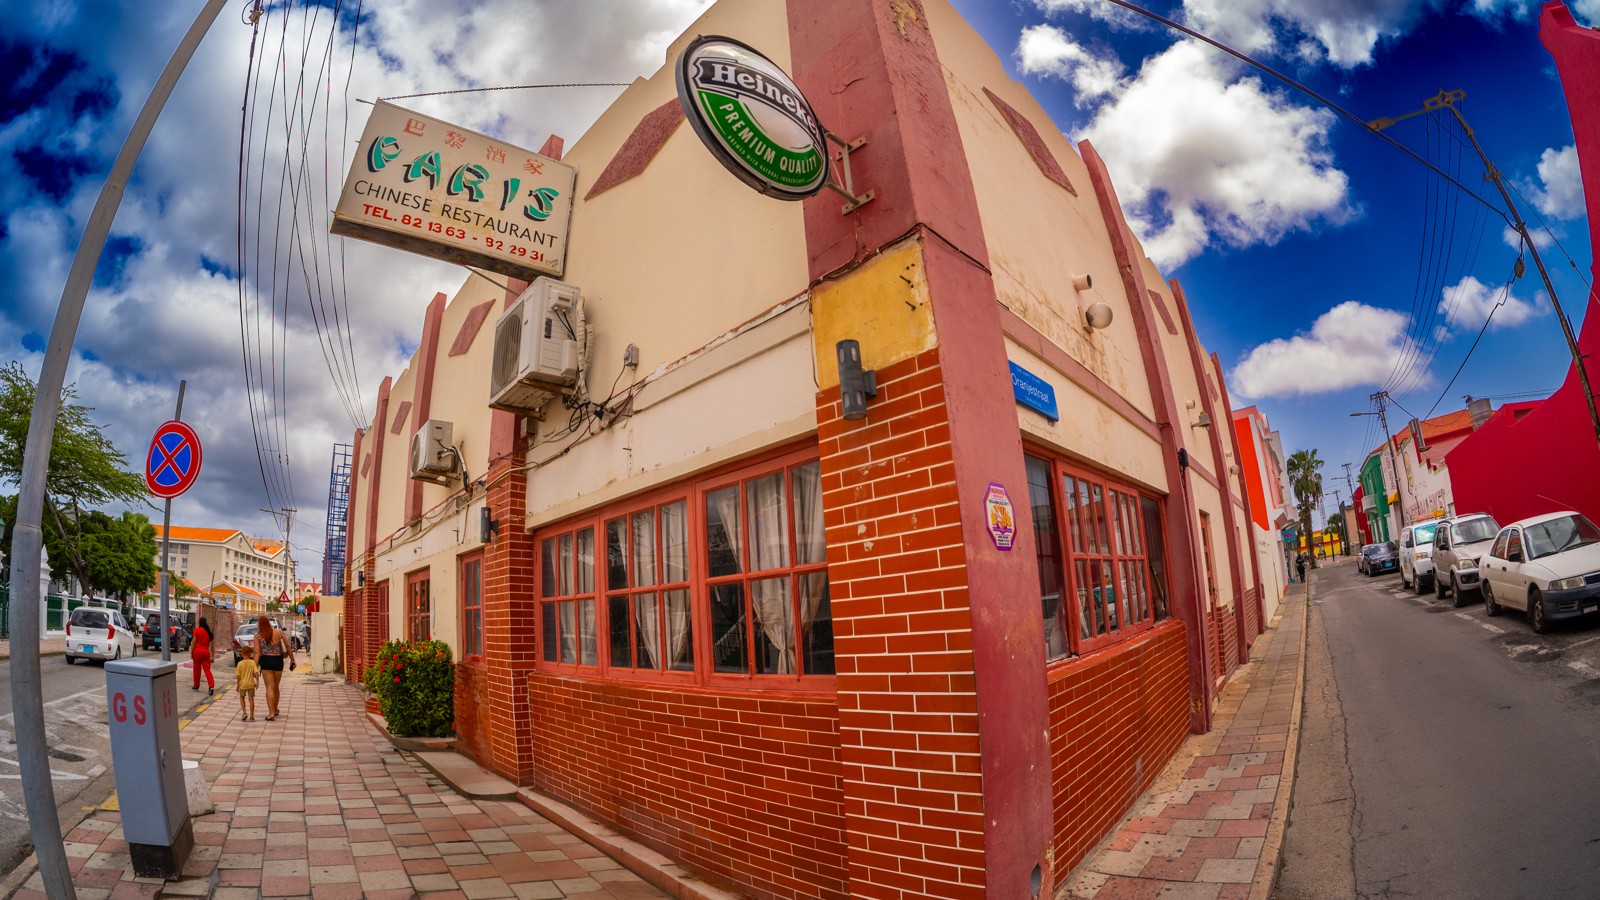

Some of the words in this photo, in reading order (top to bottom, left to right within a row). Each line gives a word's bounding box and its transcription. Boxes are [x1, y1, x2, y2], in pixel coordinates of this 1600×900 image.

[719, 103, 776, 165] PREMIUM
[779, 155, 817, 174] QUALITY
[727, 135, 746, 155] BREWED
[746, 154, 759, 166] WITH
[363, 203, 397, 221] TEL.
[367, 135, 559, 222] PARIS
[354, 180, 432, 213] CHINESE
[441, 204, 558, 248] RESTAURANT
